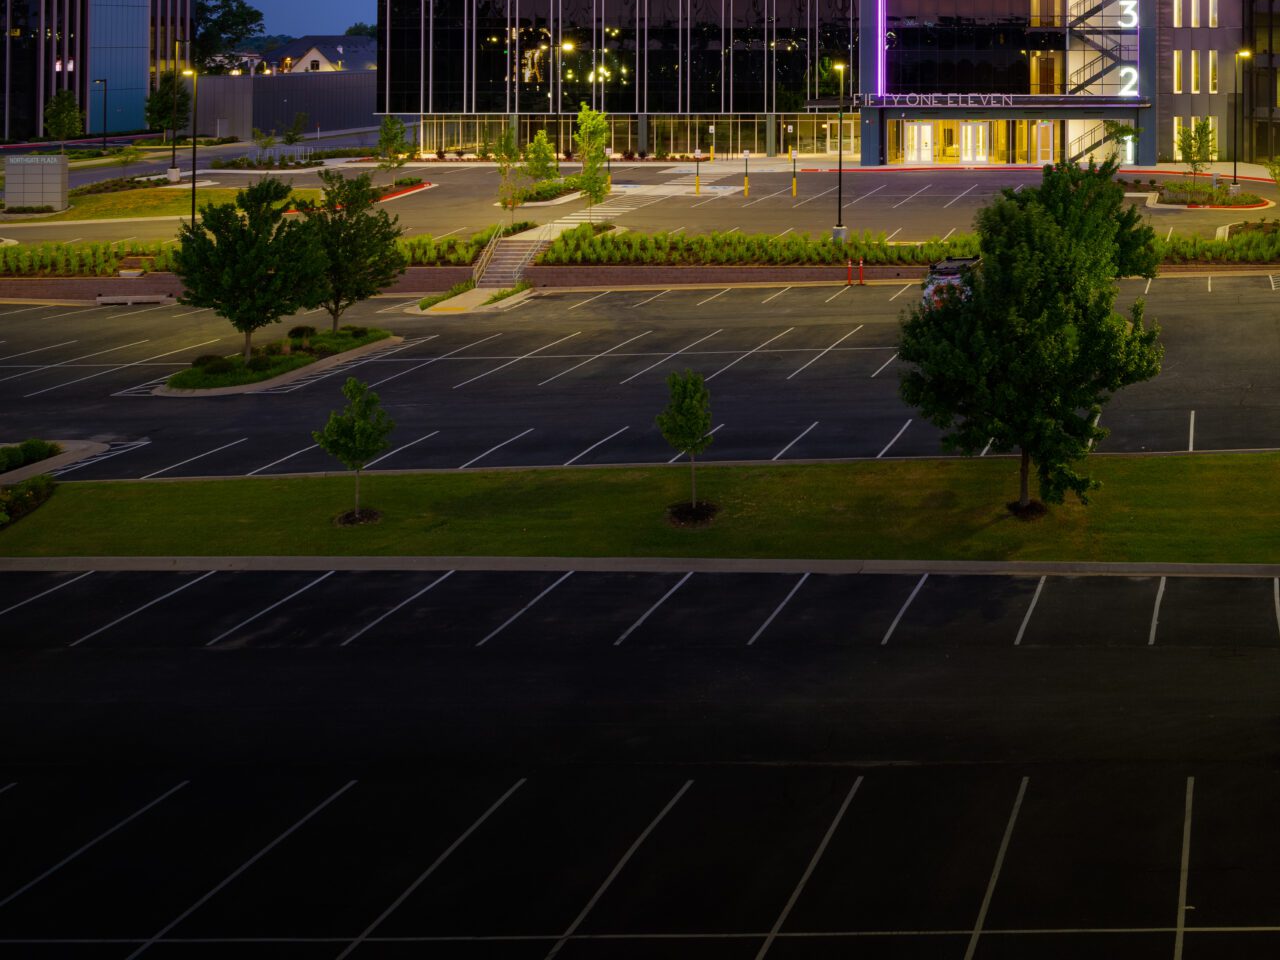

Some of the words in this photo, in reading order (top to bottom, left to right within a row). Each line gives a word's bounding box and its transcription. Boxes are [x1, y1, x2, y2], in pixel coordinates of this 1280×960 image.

[1118, 0, 1139, 28] 3
[1118, 67, 1140, 96] 2
[853, 93, 902, 107] FIFTY
[906, 93, 943, 107] ONE
[947, 93, 1013, 107] ELEVEN
